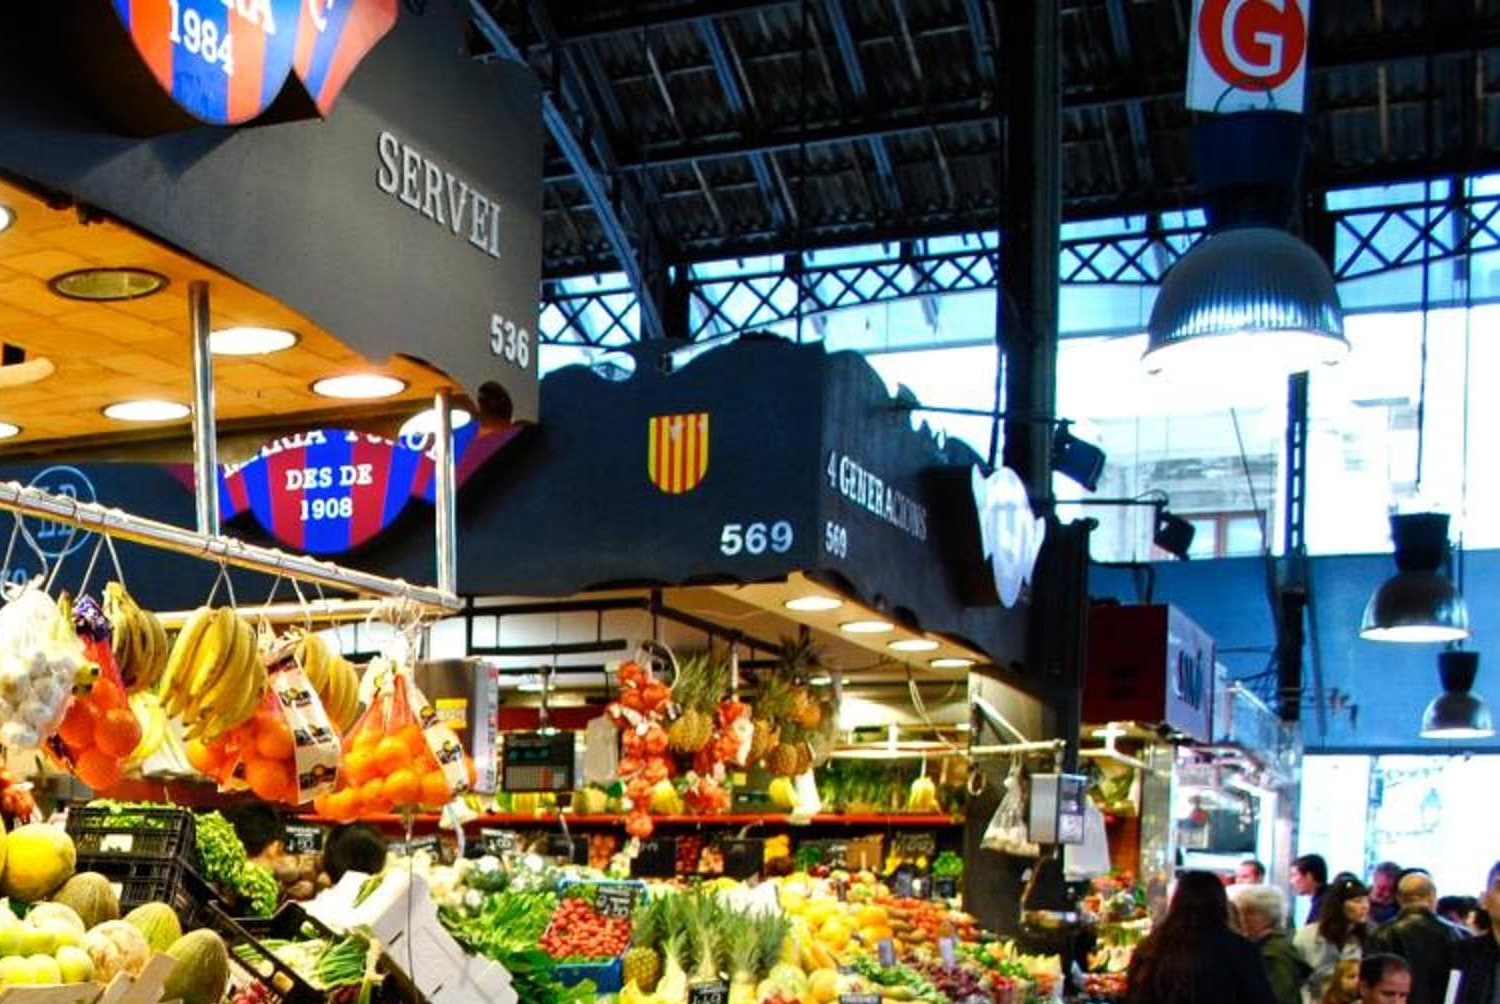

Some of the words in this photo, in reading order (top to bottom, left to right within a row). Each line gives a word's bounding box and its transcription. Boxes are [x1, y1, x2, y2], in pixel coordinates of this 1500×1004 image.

[168, 0, 235, 76] 1984
[1221, 0, 1283, 77] G
[377, 130, 501, 259] SERVEI
[490, 313, 530, 369] 536
[285, 468, 333, 490] DES
[339, 464, 373, 485] DE
[827, 451, 837, 489] 4
[299, 497, 353, 520] 1908
[719, 520, 794, 556] 569
[824, 520, 848, 560] 569
